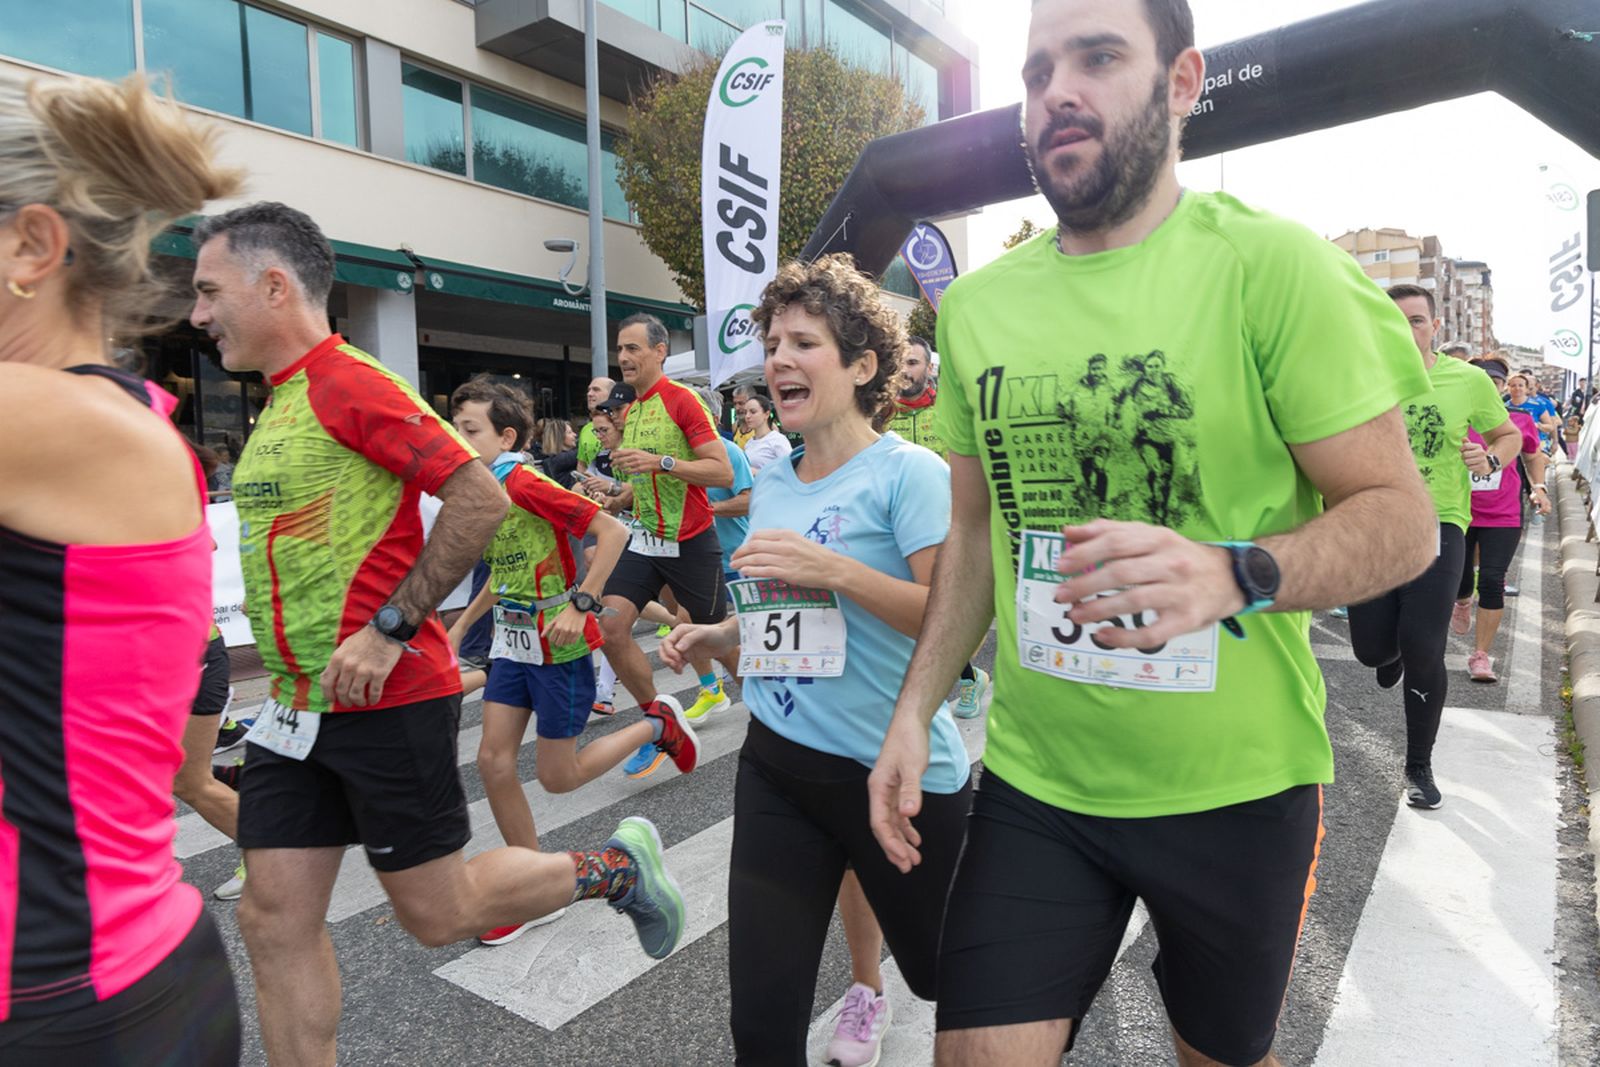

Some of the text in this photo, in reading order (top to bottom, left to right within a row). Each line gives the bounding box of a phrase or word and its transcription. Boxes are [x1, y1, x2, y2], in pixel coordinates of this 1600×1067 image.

[730, 72, 775, 91] CSIF
[1200, 63, 1263, 95] pal de
[715, 142, 769, 275] CSIF
[976, 366, 1005, 421] 17
[1006, 373, 1059, 419] XI
[1011, 432, 1090, 445] CARRERA
[1016, 447, 1092, 460] POPUL
[1031, 537, 1062, 572] XI
[736, 582, 761, 605] XI
[763, 611, 801, 652] 51
